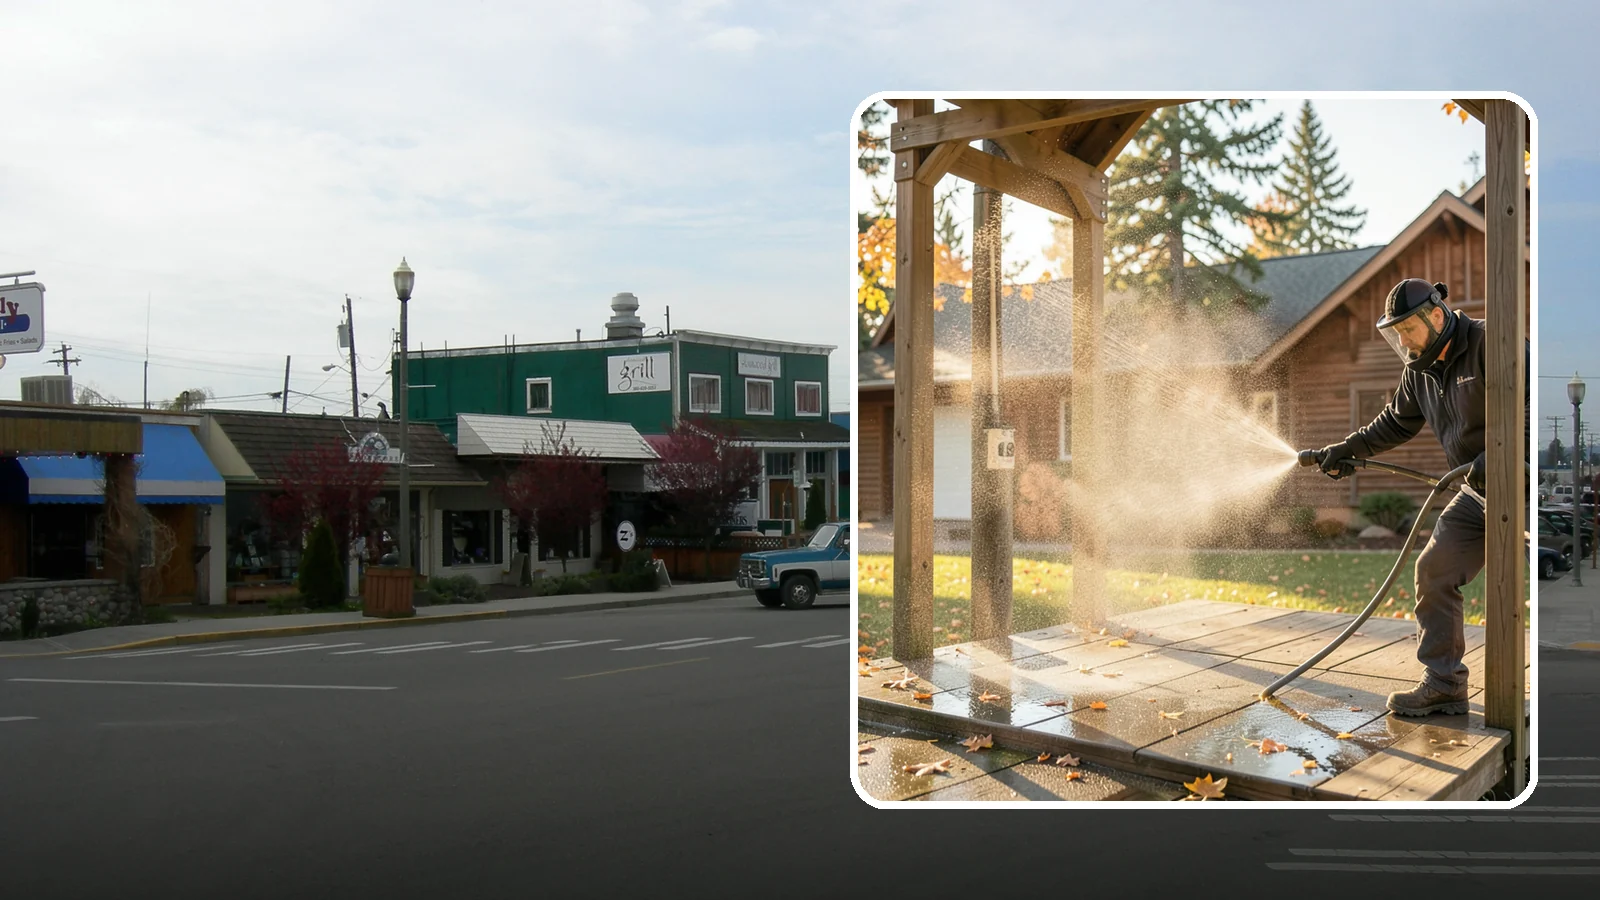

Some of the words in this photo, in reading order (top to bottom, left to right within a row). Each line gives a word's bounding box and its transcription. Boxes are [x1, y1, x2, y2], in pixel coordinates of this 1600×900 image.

[3, 338, 16, 346] Fries
[20, 336, 38, 345] Salads
[617, 356, 655, 391] grill
